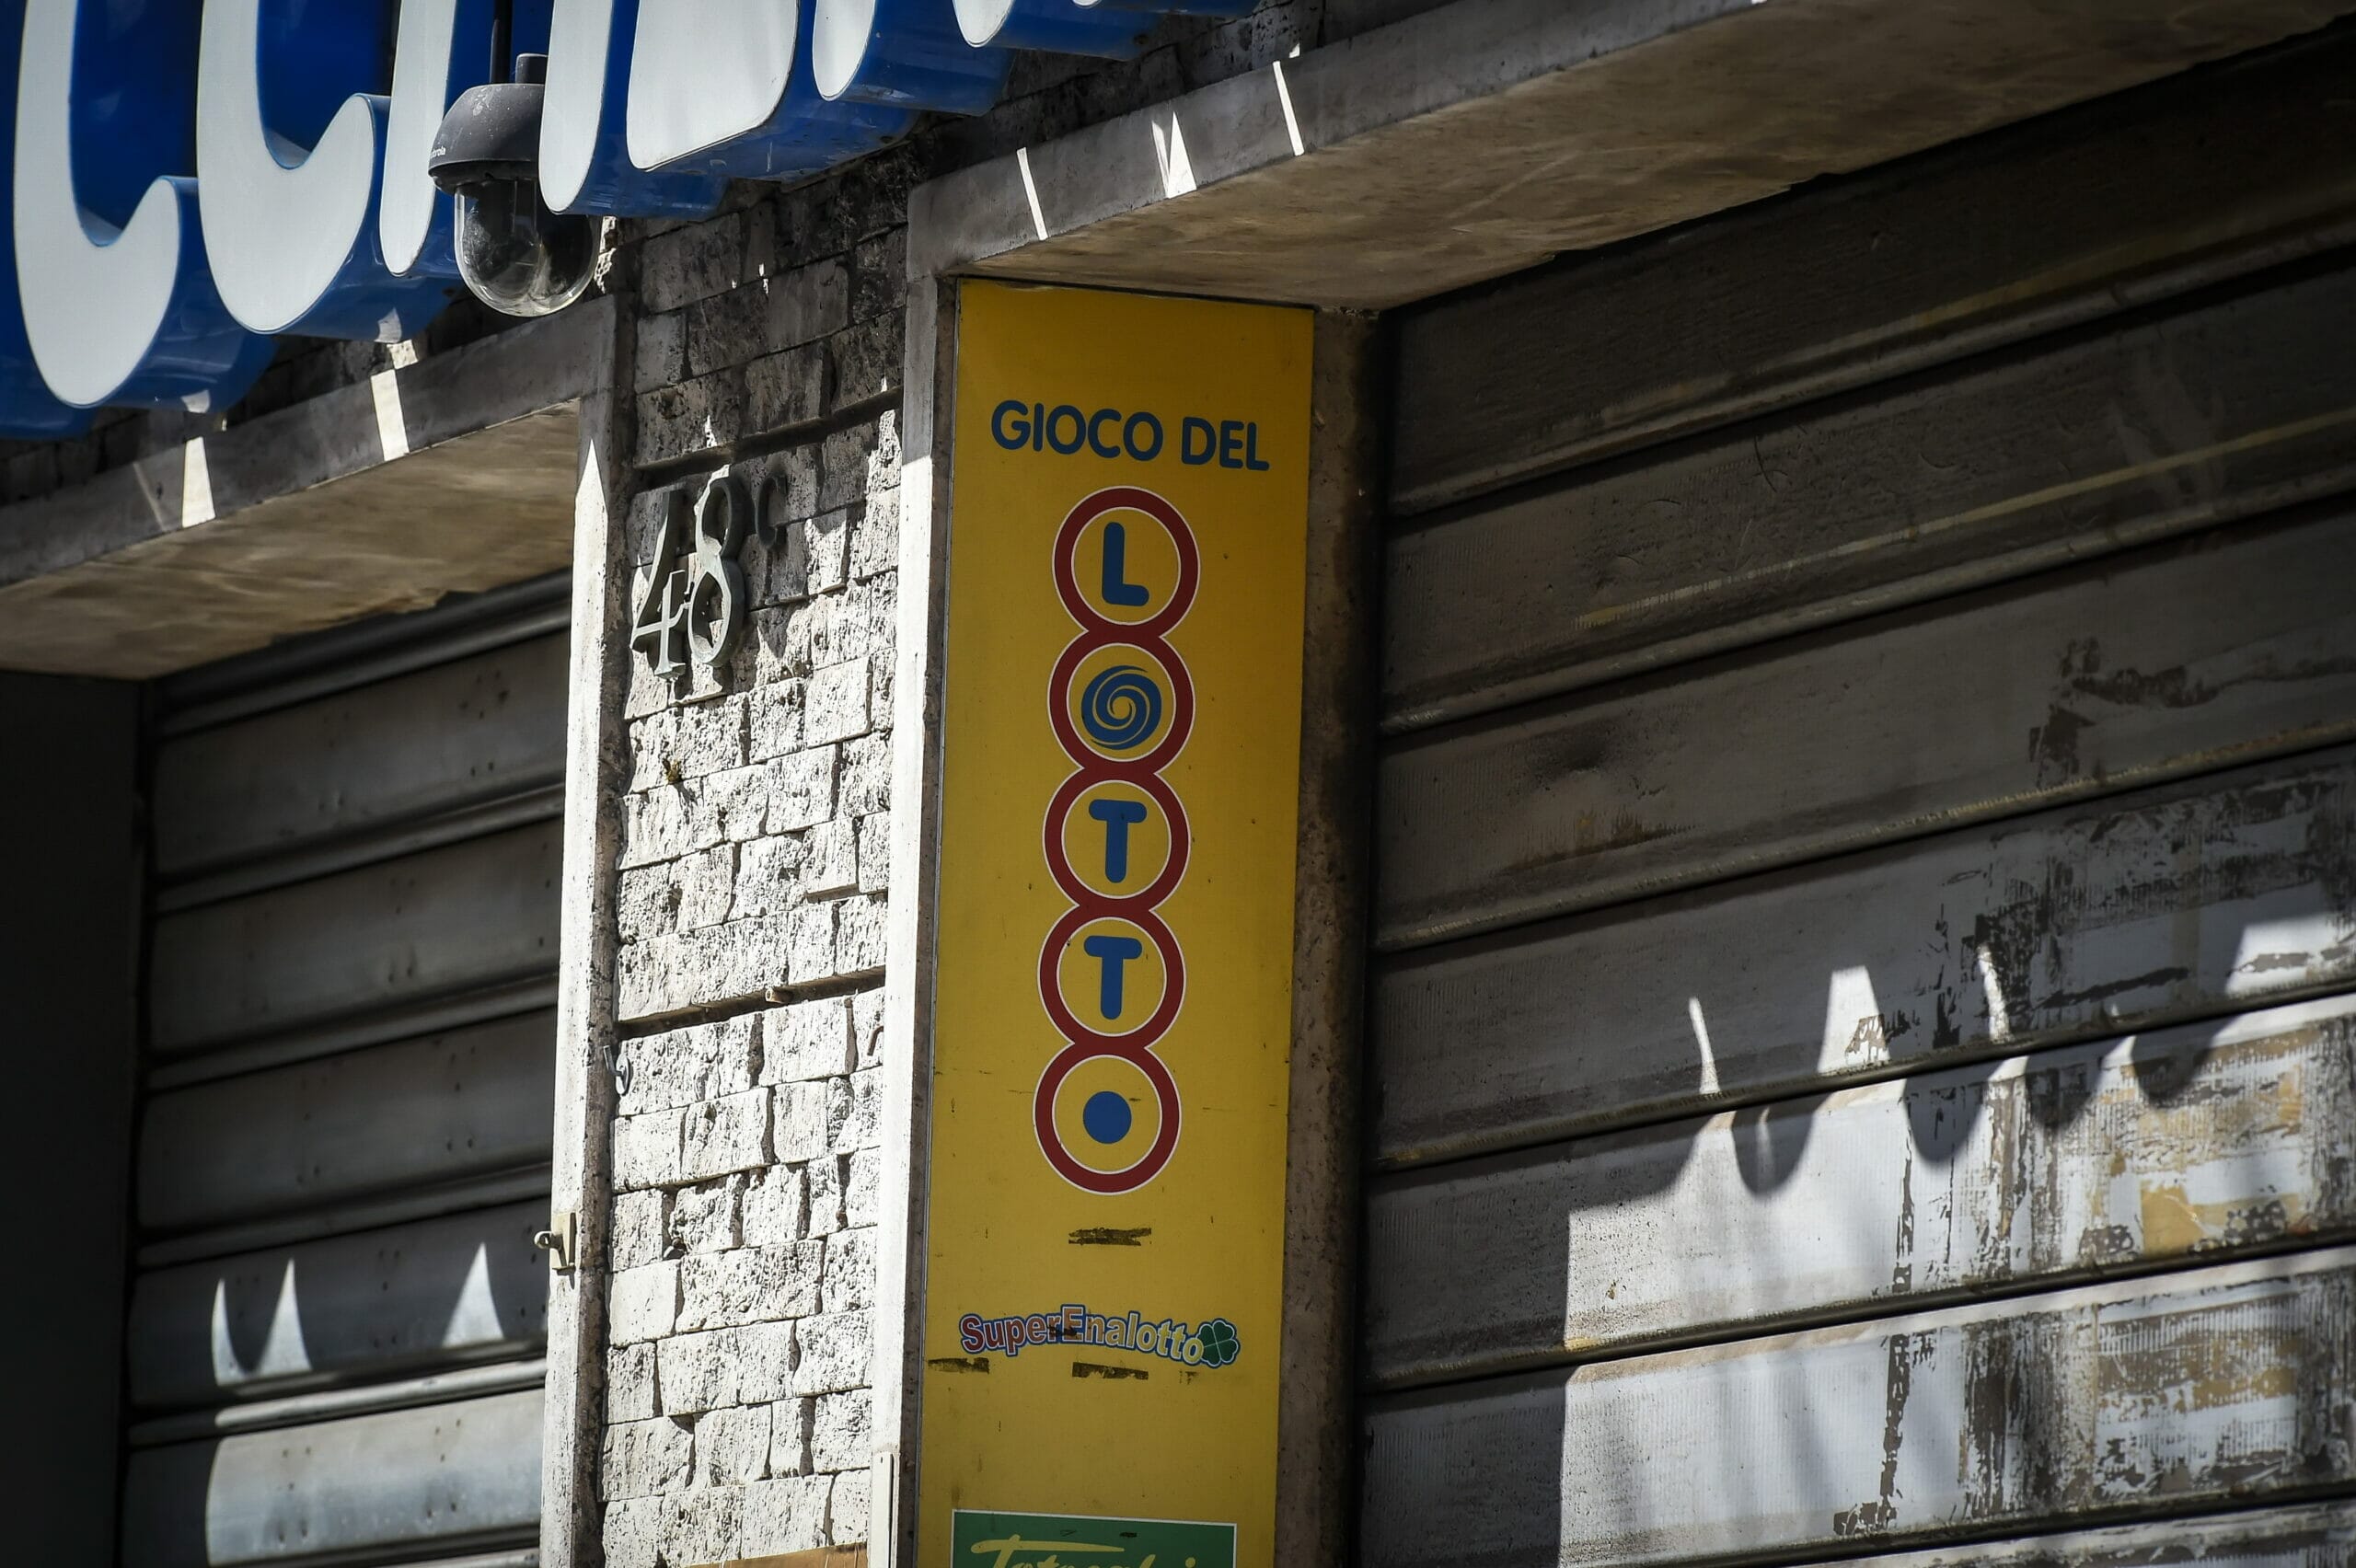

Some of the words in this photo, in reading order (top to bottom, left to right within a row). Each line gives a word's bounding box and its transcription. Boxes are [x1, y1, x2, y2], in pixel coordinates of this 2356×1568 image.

[991, 399, 1163, 462] GIOCO
[1181, 417, 1270, 471] DEL
[959, 1304, 1205, 1366] SuperEnalotto
